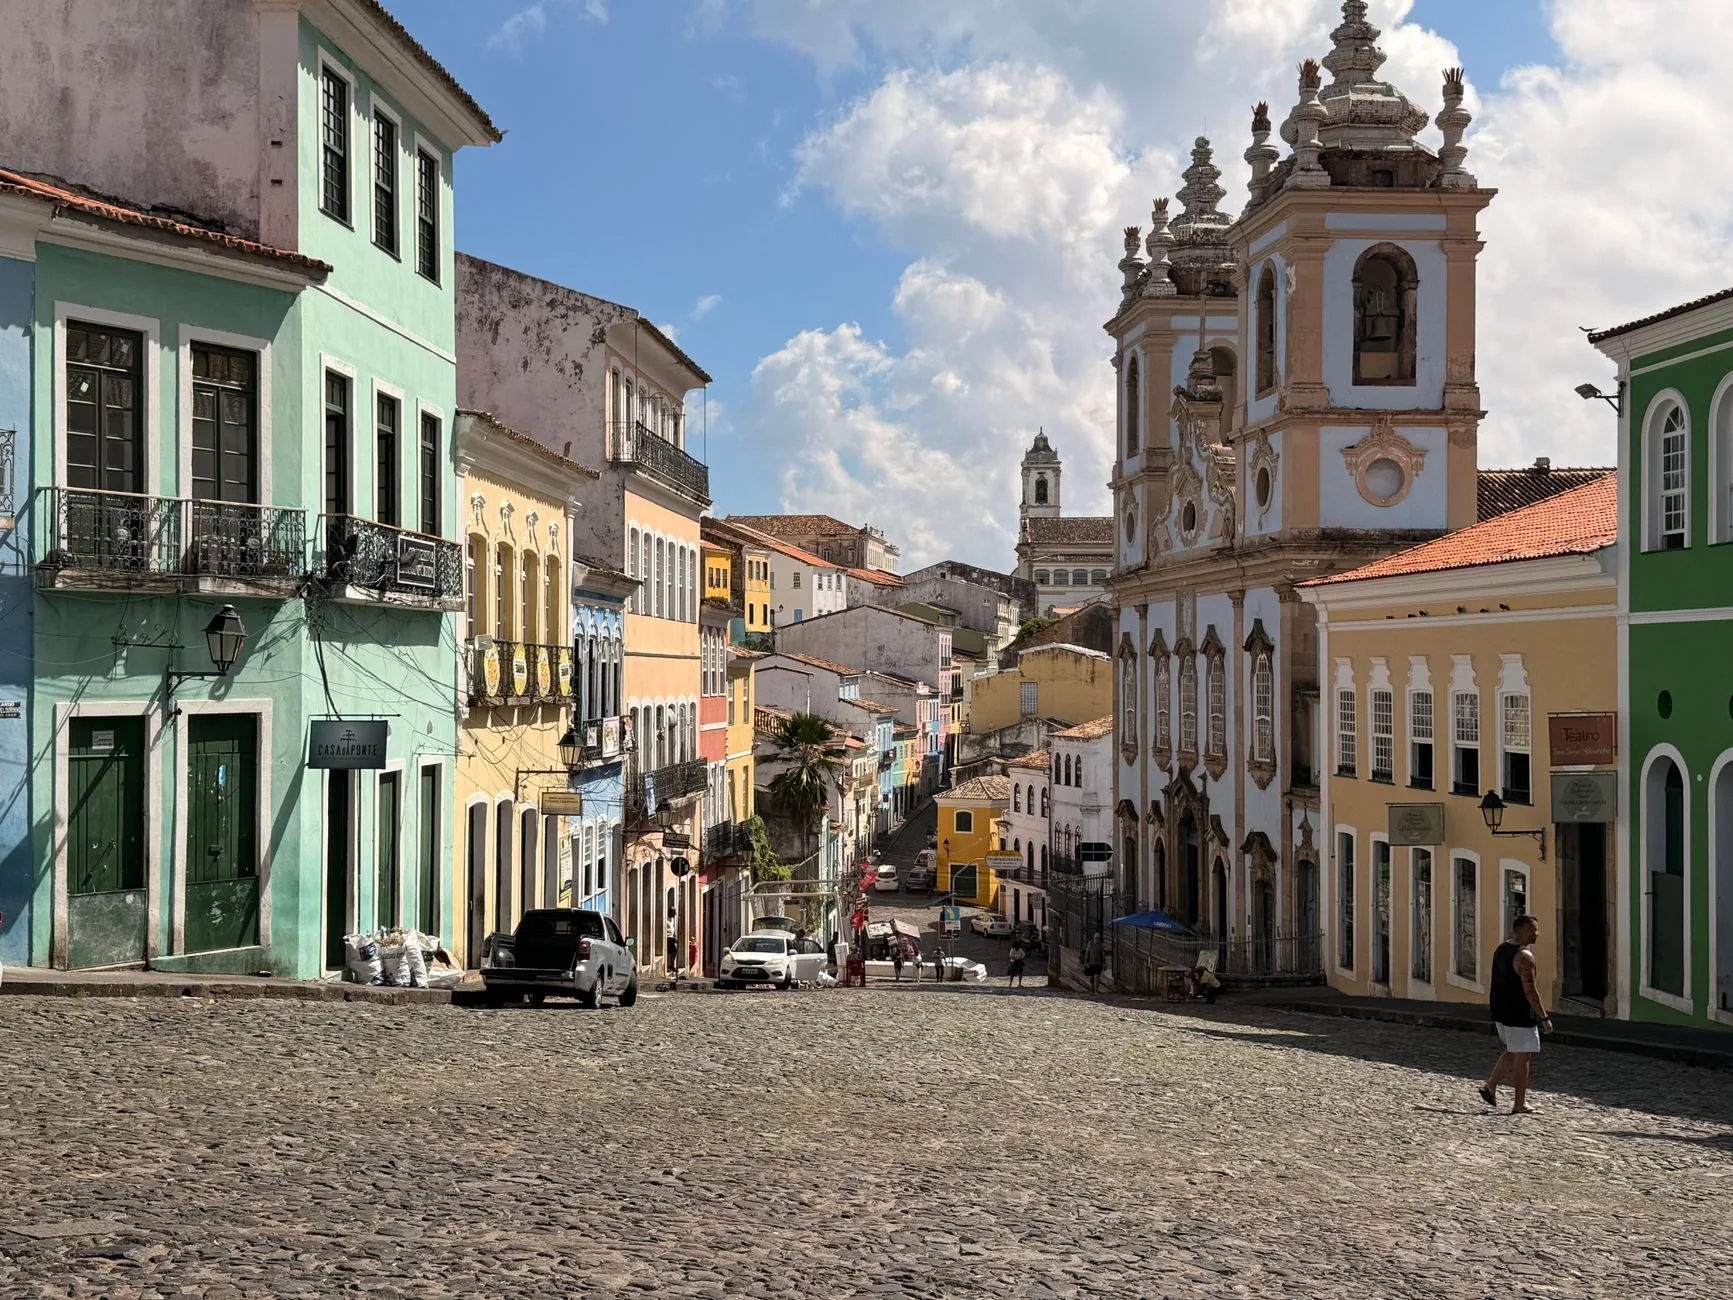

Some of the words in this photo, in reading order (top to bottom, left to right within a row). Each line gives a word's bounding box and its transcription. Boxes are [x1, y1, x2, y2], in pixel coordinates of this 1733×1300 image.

[1562, 727, 1600, 742] Teatro
[318, 744, 341, 756] CASA
[351, 744, 378, 756] PONTE
